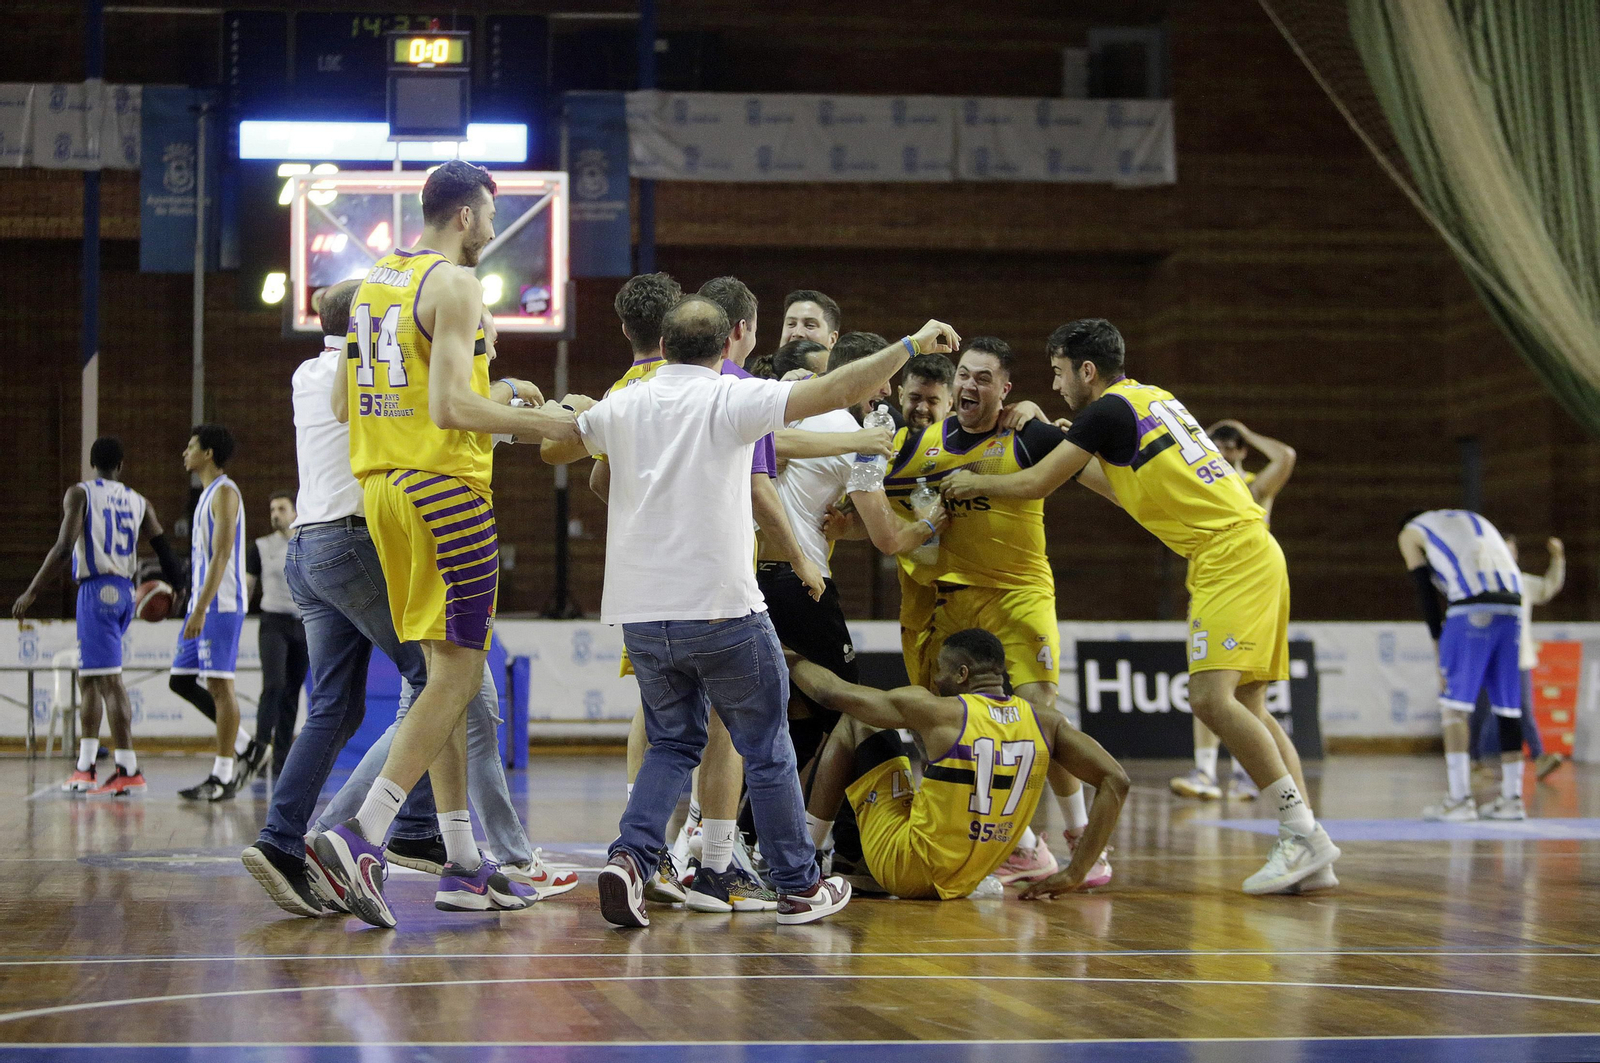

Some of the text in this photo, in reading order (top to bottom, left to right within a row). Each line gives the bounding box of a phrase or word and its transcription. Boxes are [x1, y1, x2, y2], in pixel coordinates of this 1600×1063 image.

[354, 303, 408, 388] 14
[359, 393, 400, 417] 95 ANYS
[383, 408, 414, 418] BASQUET
[384, 402, 399, 410] FENT
[1196, 460, 1225, 484] 95
[102, 508, 135, 557] 15
[1037, 645, 1054, 670] 4
[1189, 630, 1209, 663] 5
[1084, 659, 1291, 714] Huea
[967, 736, 1036, 816] 17
[968, 820, 996, 842] 95
